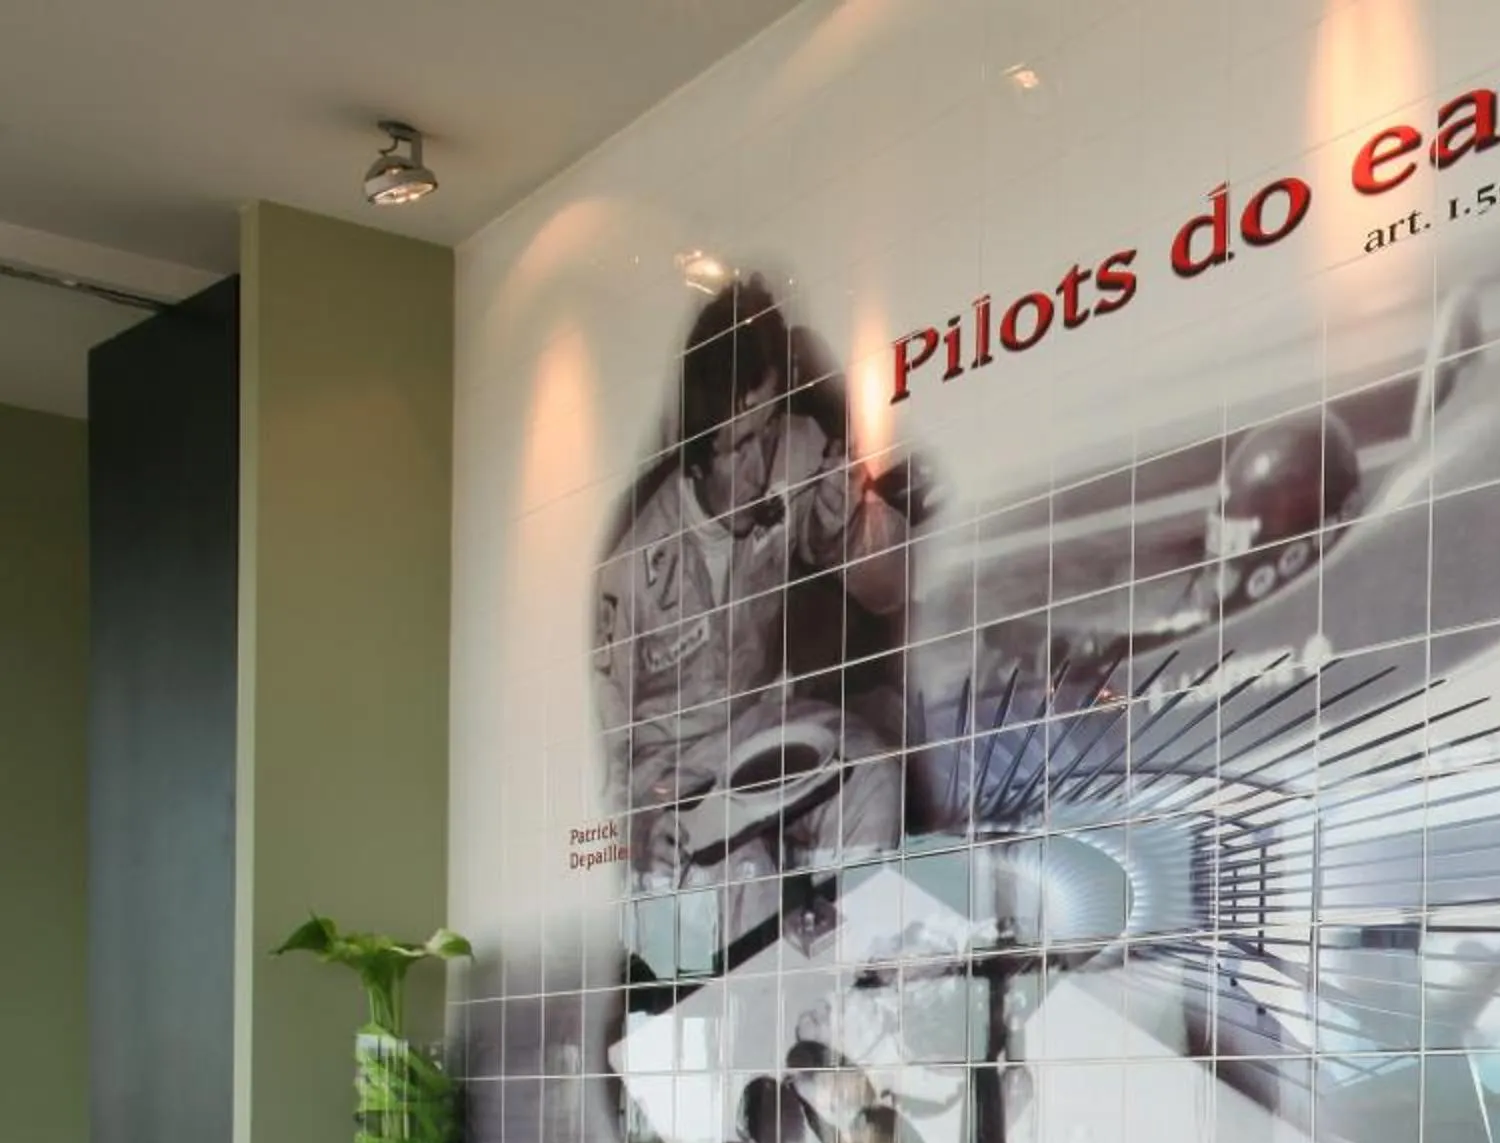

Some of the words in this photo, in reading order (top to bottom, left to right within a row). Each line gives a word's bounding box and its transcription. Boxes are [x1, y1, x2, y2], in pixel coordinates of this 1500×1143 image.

[1363, 208, 1432, 253] art.
[890, 247, 1138, 405] Pilots
[1170, 177, 1312, 279] do
[569, 821, 619, 845] Patrick
